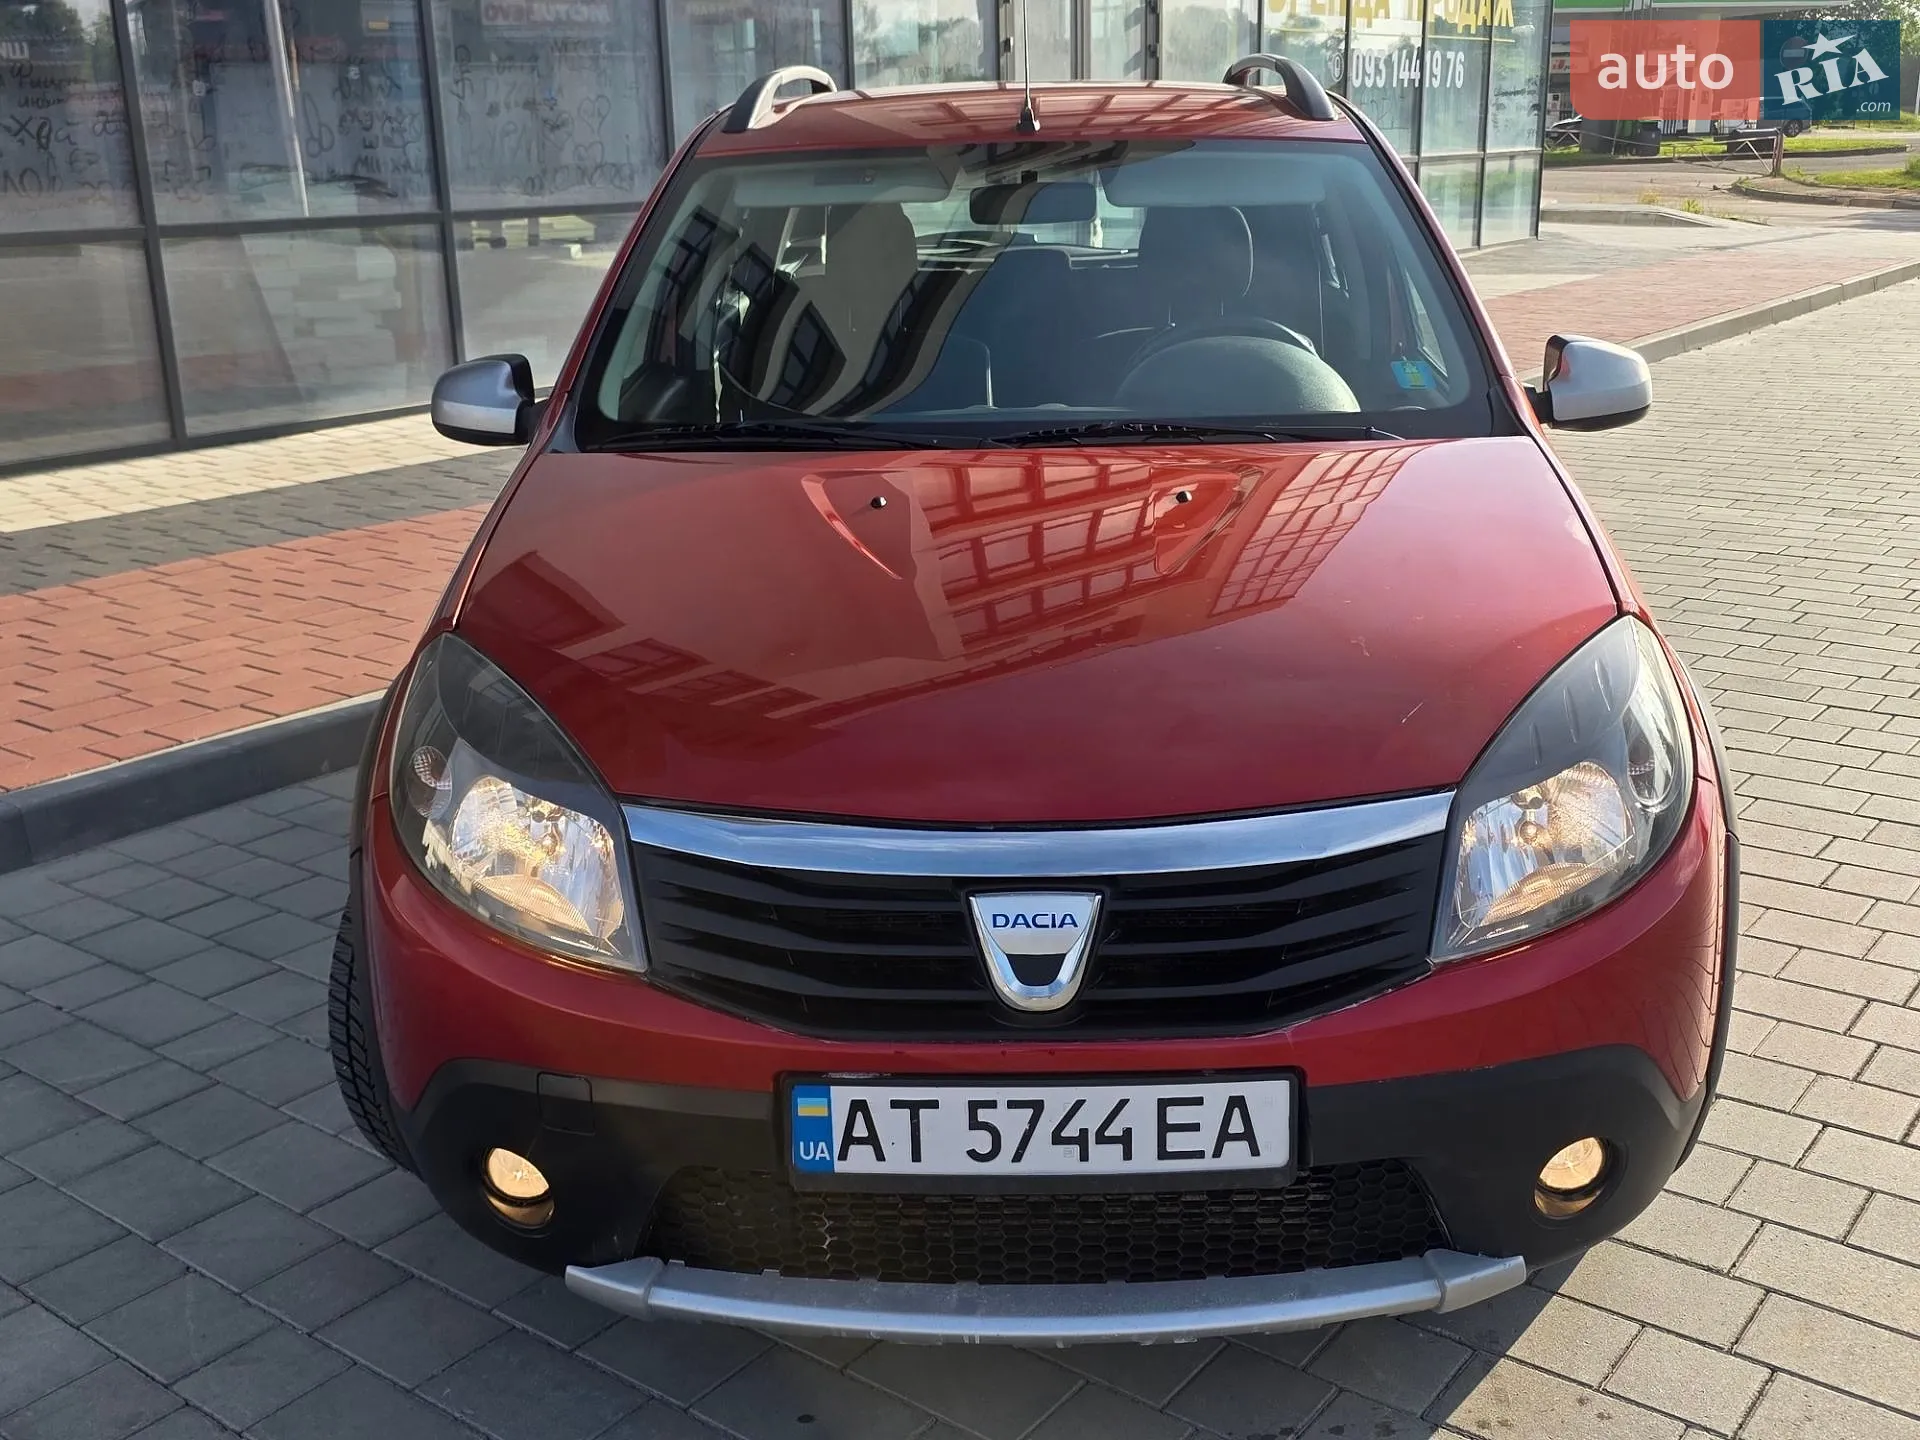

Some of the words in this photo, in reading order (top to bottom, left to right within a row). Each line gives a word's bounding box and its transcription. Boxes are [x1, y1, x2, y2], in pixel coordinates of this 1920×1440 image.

[1352, 48, 1386, 88] 093
[1392, 49, 1420, 88] 144
[1424, 50, 1442, 88] 19
[1446, 51, 1465, 89] 76
[991, 912, 1078, 929] DACIA
[837, 1099, 940, 1162] AT
[965, 1098, 1133, 1163] 5744
[1156, 1095, 1261, 1161] EA
[799, 1141, 831, 1161] UA
